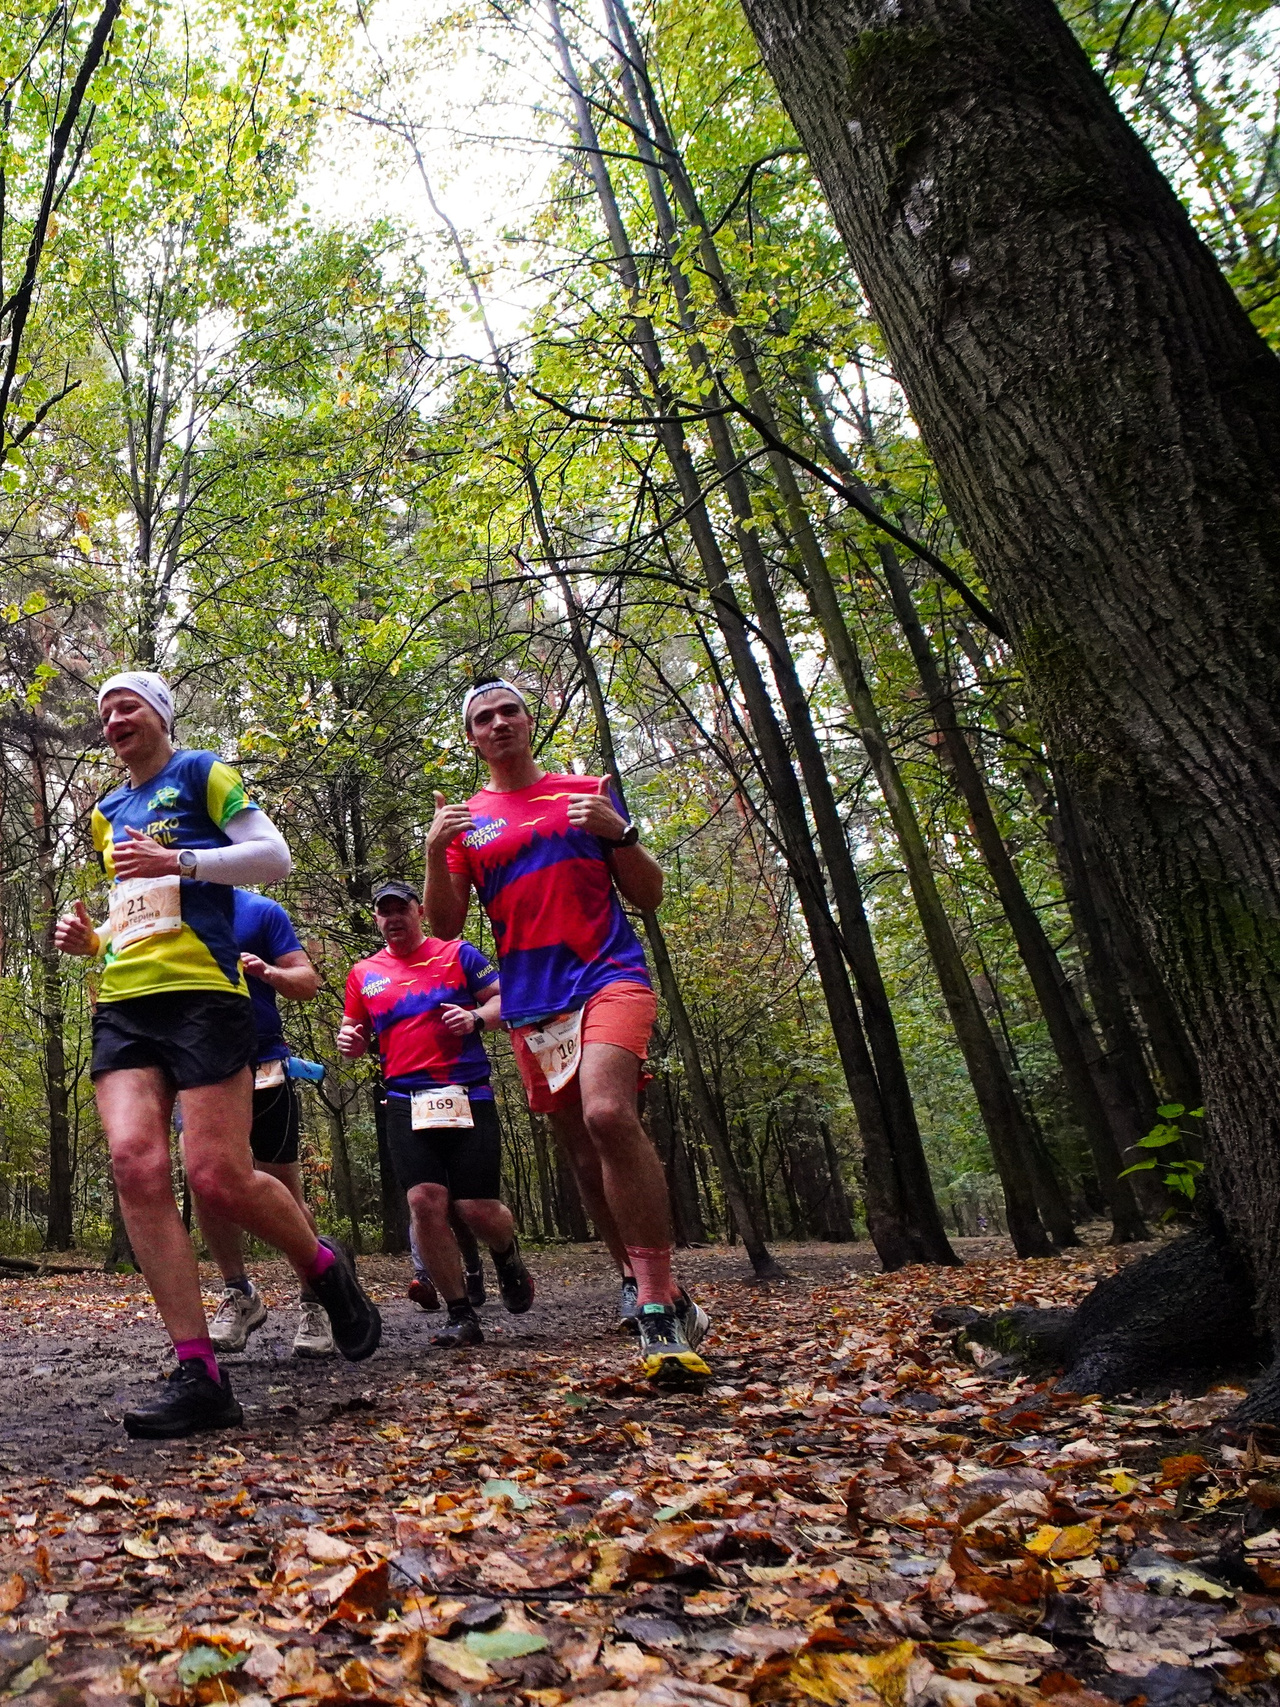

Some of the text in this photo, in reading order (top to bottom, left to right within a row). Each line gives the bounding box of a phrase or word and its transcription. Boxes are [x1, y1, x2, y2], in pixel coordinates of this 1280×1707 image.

[462, 818, 507, 847] UGRESHA
[473, 831, 502, 850] TRAIL
[127, 895, 146, 916] 21
[361, 977, 391, 995] UGRESHA
[367, 987, 386, 998] TRAIL
[428, 1099, 453, 1110] 169
